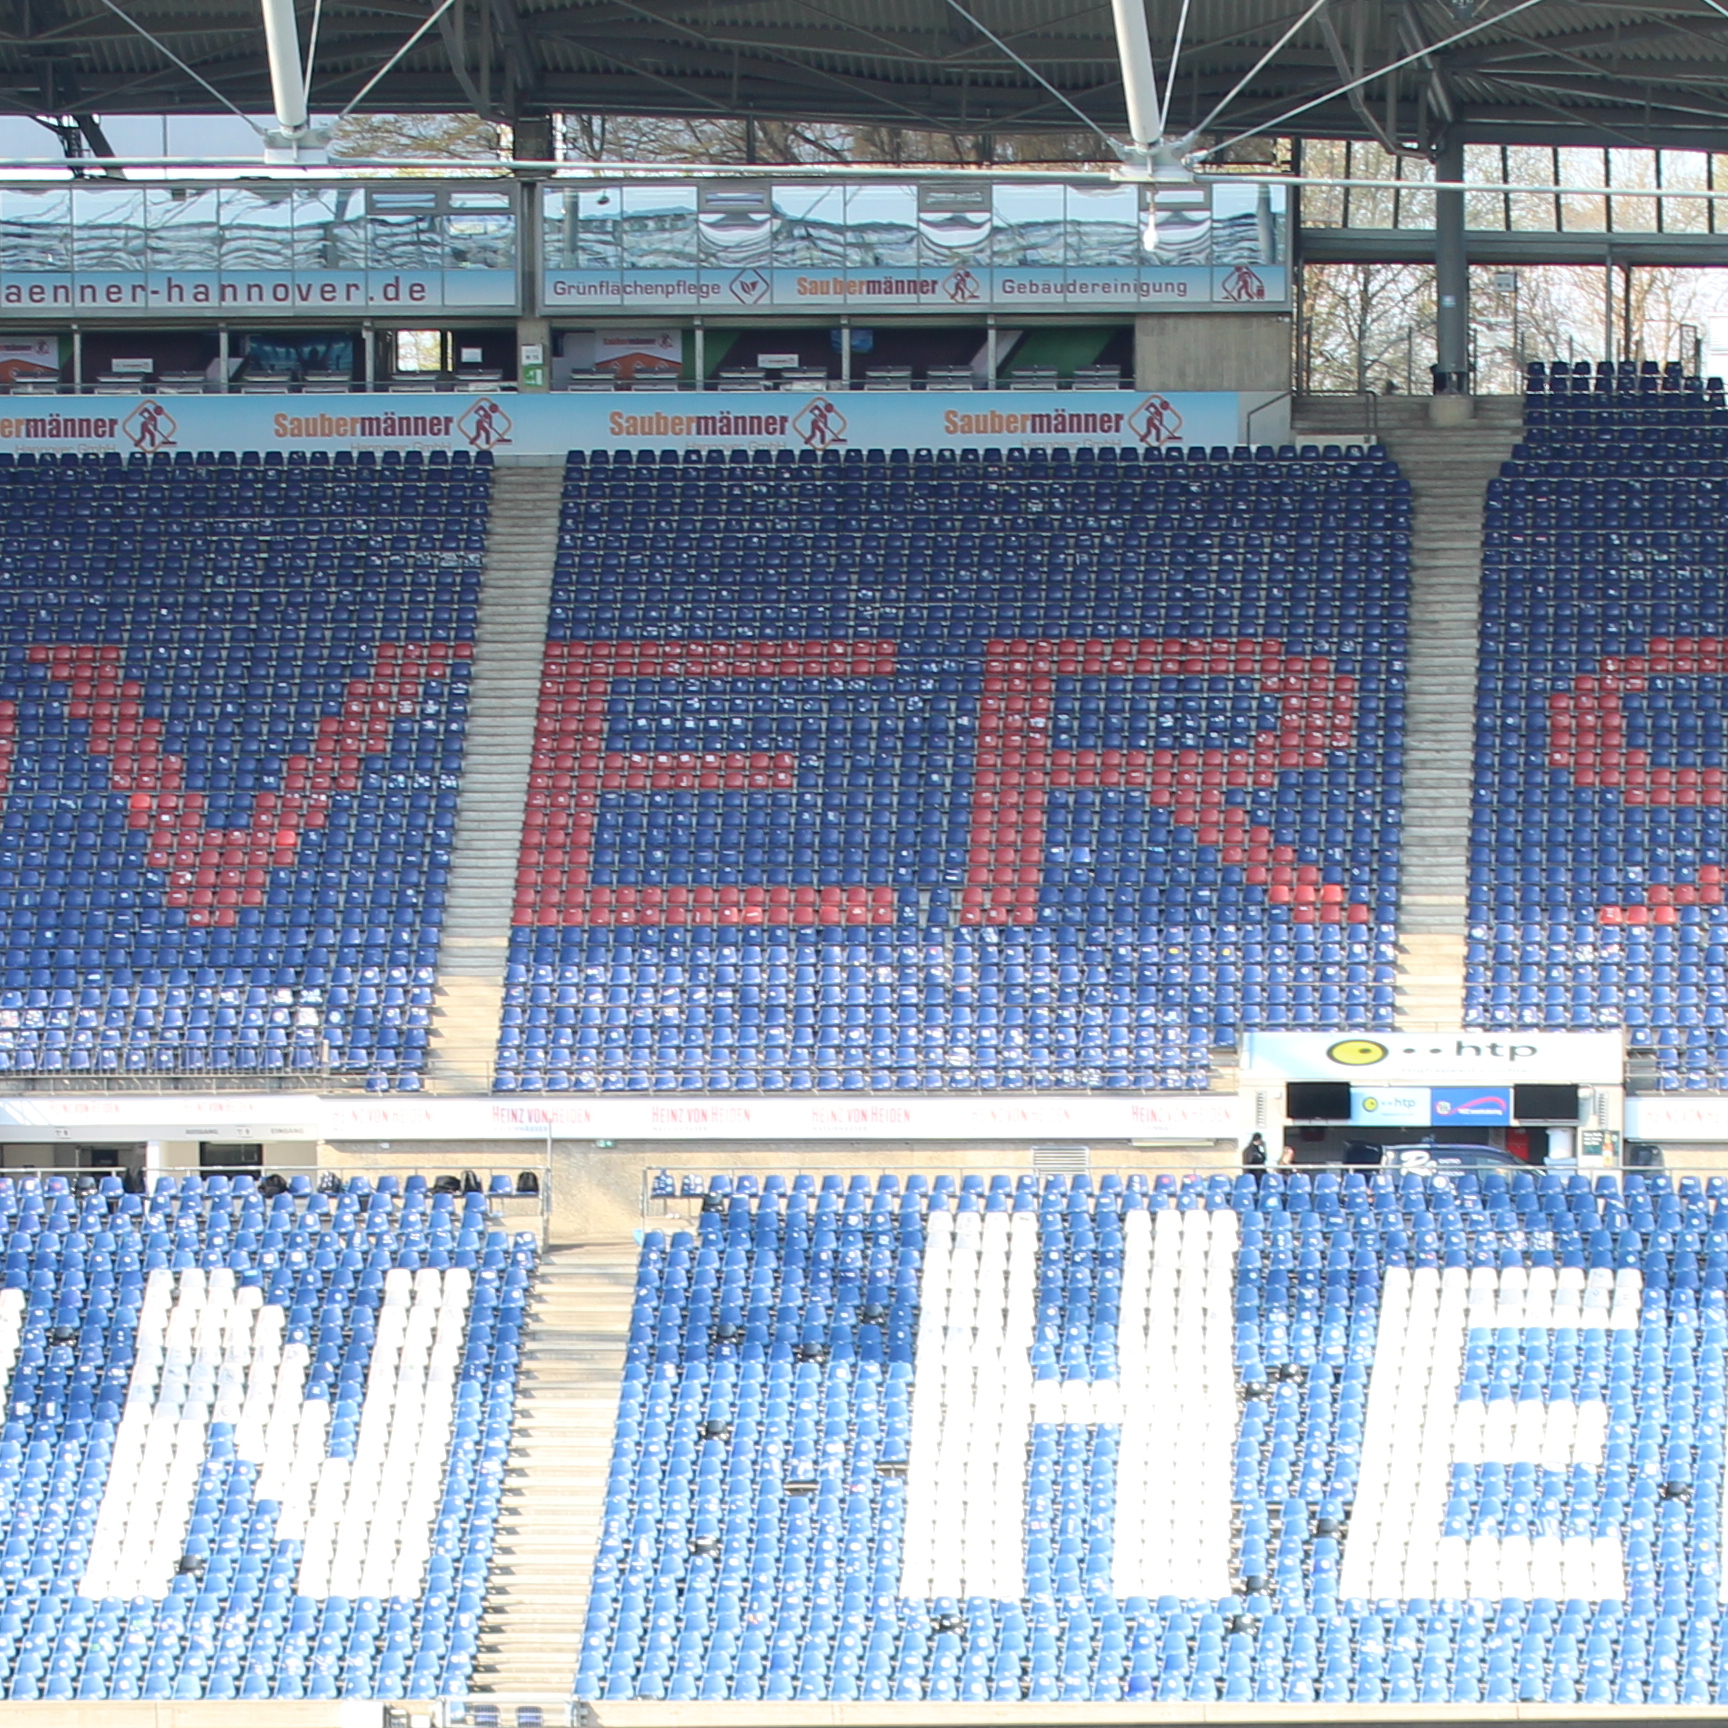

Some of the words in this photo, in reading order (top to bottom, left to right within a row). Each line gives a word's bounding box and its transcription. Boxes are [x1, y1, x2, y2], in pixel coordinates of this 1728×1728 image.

[553, 279, 721, 299] Grünflächenpflege
[797, 275, 939, 297] Saubermänner
[1002, 277, 1188, 297] Gebäudereinigung
[274, 411, 454, 438] Saubermänner
[609, 410, 789, 437] Saubermänner
[943, 408, 1124, 435] Saubermänner
[1456, 1040, 1537, 1061] htp
[527, 1107, 549, 1123] VON
[687, 1107, 708, 1123] VON
[847, 1107, 868, 1123] VON
